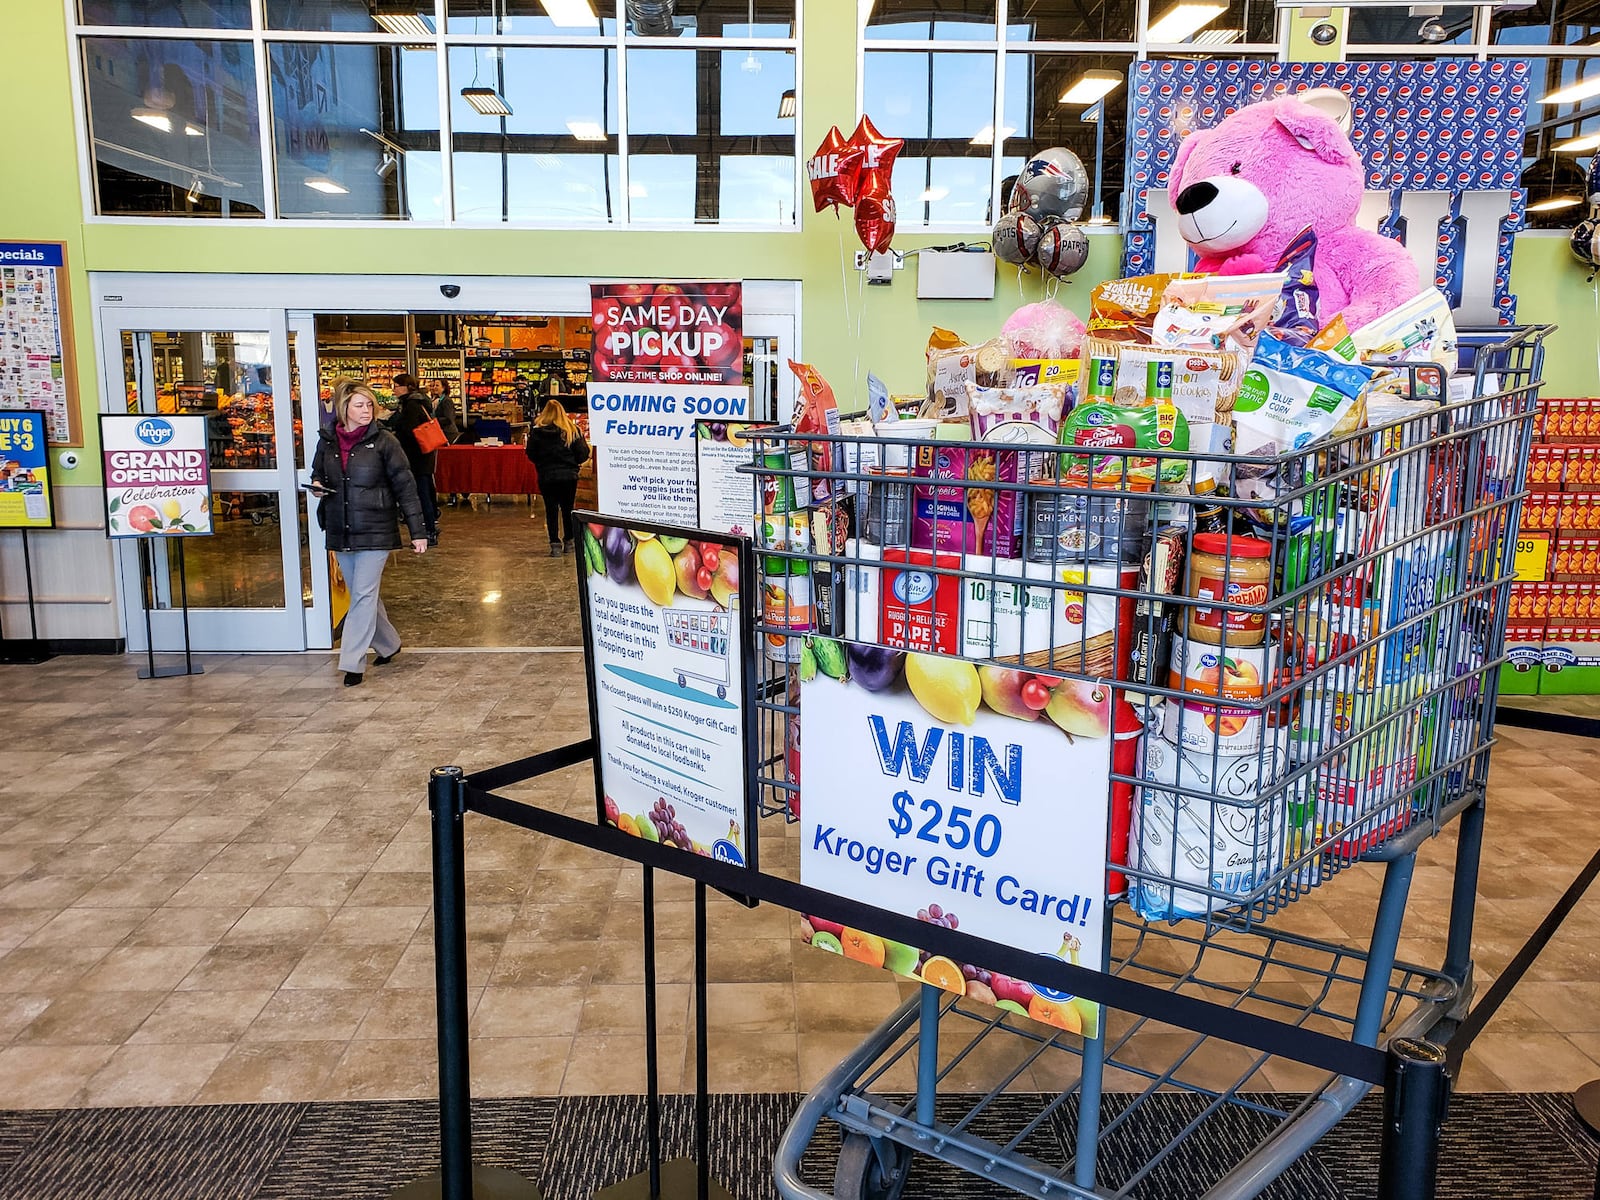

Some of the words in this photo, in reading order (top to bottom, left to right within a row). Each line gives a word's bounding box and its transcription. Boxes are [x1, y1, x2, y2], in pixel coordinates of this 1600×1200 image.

[807, 154, 839, 180] SALE
[607, 305, 671, 326] SAME
[679, 305, 728, 326] DAY
[611, 331, 723, 357] PICKUP
[659, 372, 683, 380] SHOP
[685, 373, 722, 382] ONLINE!
[591, 394, 675, 413] COMING
[683, 397, 745, 415] SOON
[1273, 392, 1294, 405] BLUE
[1269, 402, 1290, 414] CORN
[0, 418, 20, 432] UY
[22, 418, 33, 432] 6
[138, 421, 172, 444] Kroger
[606, 420, 684, 440] February
[13, 433, 34, 451] $3
[1083, 435, 1123, 448] French
[110, 451, 202, 469] GRAND
[922, 446, 930, 459] 5
[111, 468, 203, 483] OPENING!
[649, 476, 665, 484] pick
[667, 478, 684, 486] your
[121, 485, 196, 504] Celebration
[639, 485, 667, 493] veggies
[669, 486, 683, 494] just
[631, 501, 660, 509] satisfaction
[673, 495, 696, 503] them.
[928, 504, 957, 512] OIGINAL
[1092, 515, 1120, 523] REAS
[1516, 541, 1534, 553] 99
[970, 581, 985, 601] 10
[1228, 587, 1266, 605] CREAMY
[594, 592, 605, 605] Can
[606, 598, 618, 609] you
[619, 602, 640, 614] guess
[641, 605, 654, 618] the
[595, 608, 609, 620] total
[610, 611, 629, 626] dollar
[630, 620, 660, 635] amount
[771, 612, 801, 622] Peaces
[888, 610, 911, 622] RUGGD
[597, 622, 602, 632] of
[603, 626, 633, 643] groceries
[634, 633, 641, 645] in
[642, 636, 656, 649] this
[597, 637, 626, 658] shopping
[627, 649, 644, 661] cart?
[601, 680, 610, 692] The
[610, 684, 626, 697] closest
[626, 692, 642, 704] guess
[642, 697, 652, 707] will
[652, 701, 663, 711] win
[667, 705, 683, 718] $250
[683, 710, 705, 725] Kroger
[705, 717, 718, 730] Gift
[719, 722, 738, 735] Card!
[1211, 706, 1232, 714] HAVY
[621, 720, 629, 730] All
[630, 724, 656, 741] products
[656, 732, 662, 742] in
[663, 736, 675, 748] this
[675, 742, 689, 754] cart
[689, 745, 701, 757] will
[701, 749, 711, 762] be
[626, 735, 650, 750] donated
[650, 743, 658, 753] to
[658, 745, 672, 759] local
[672, 751, 706, 773] foodbanks.
[867, 714, 1023, 806] WIN
[608, 752, 622, 764] Thank
[622, 760, 633, 771] you
[641, 768, 656, 784] being
[662, 778, 682, 795] valued,
[683, 786, 704, 803] Kroger
[888, 790, 1002, 858] $250
[1229, 804, 1281, 839] Spon
[813, 823, 917, 876] Kroger
[926, 856, 985, 898] Gift
[995, 875, 1092, 927] Card!
